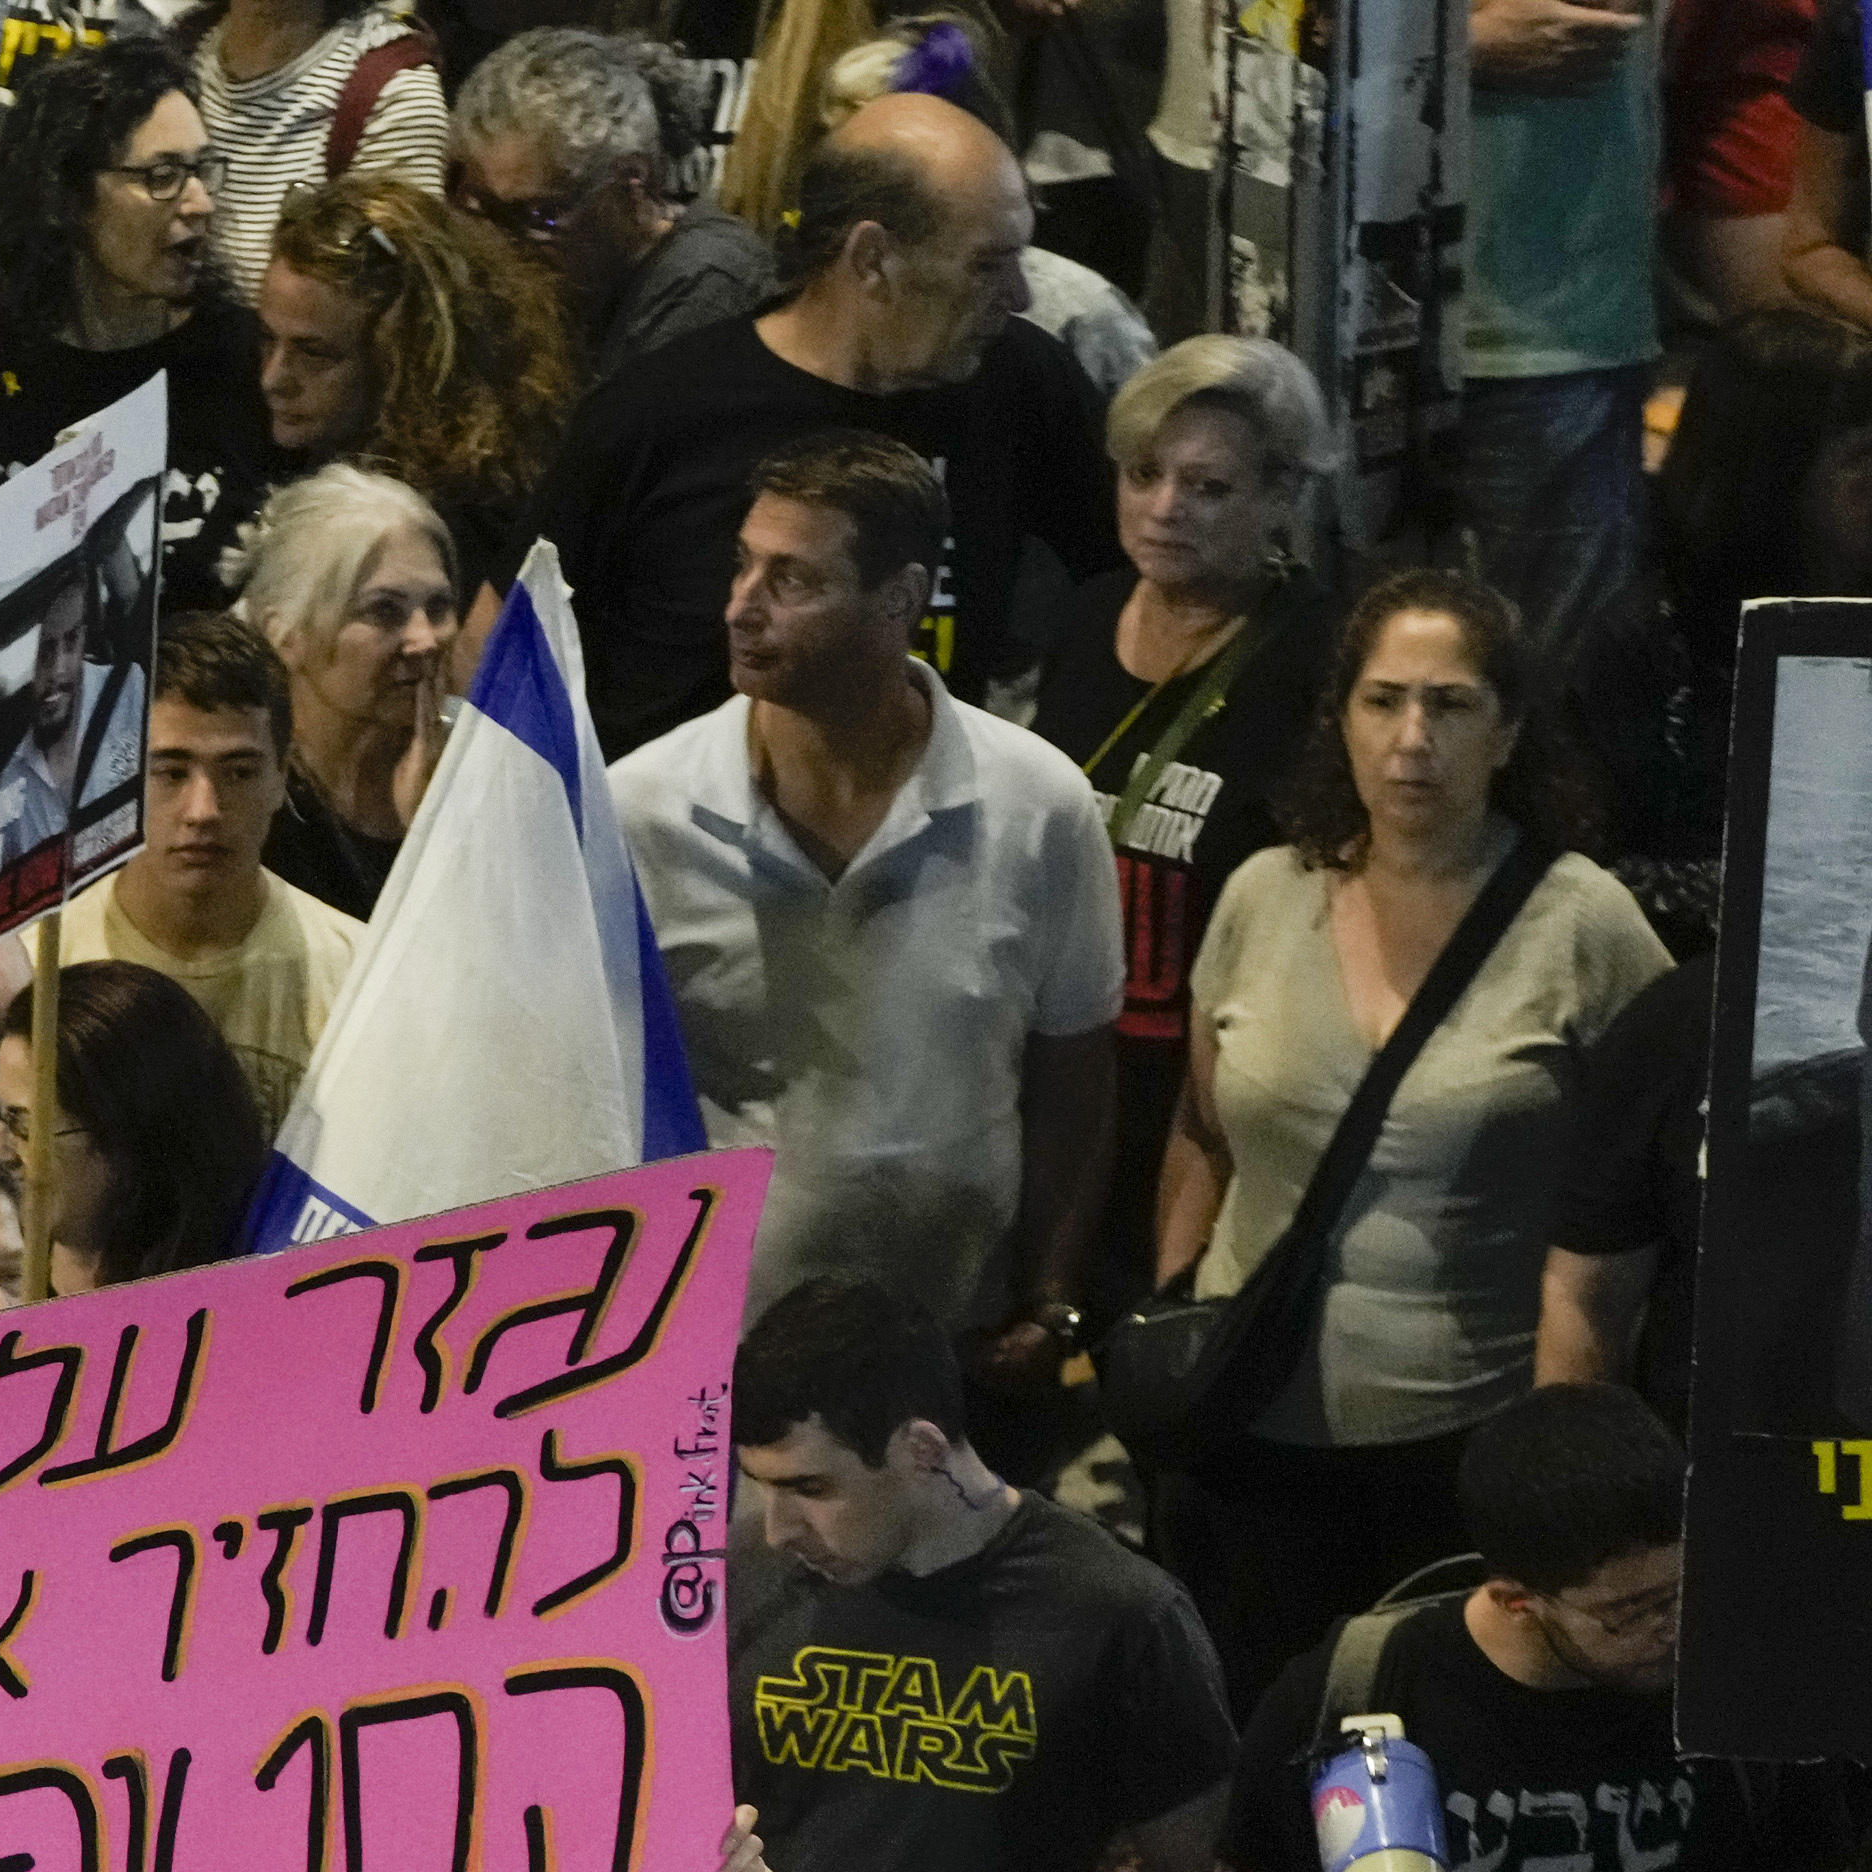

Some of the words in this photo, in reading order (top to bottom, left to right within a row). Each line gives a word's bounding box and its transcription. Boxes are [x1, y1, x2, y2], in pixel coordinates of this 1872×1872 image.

[283, 1184, 726, 1420] נגזר
[109, 1425, 643, 1685] להחזיר
[756, 1700, 1038, 1795] WARS
[757, 1644, 1037, 1736] STAM
